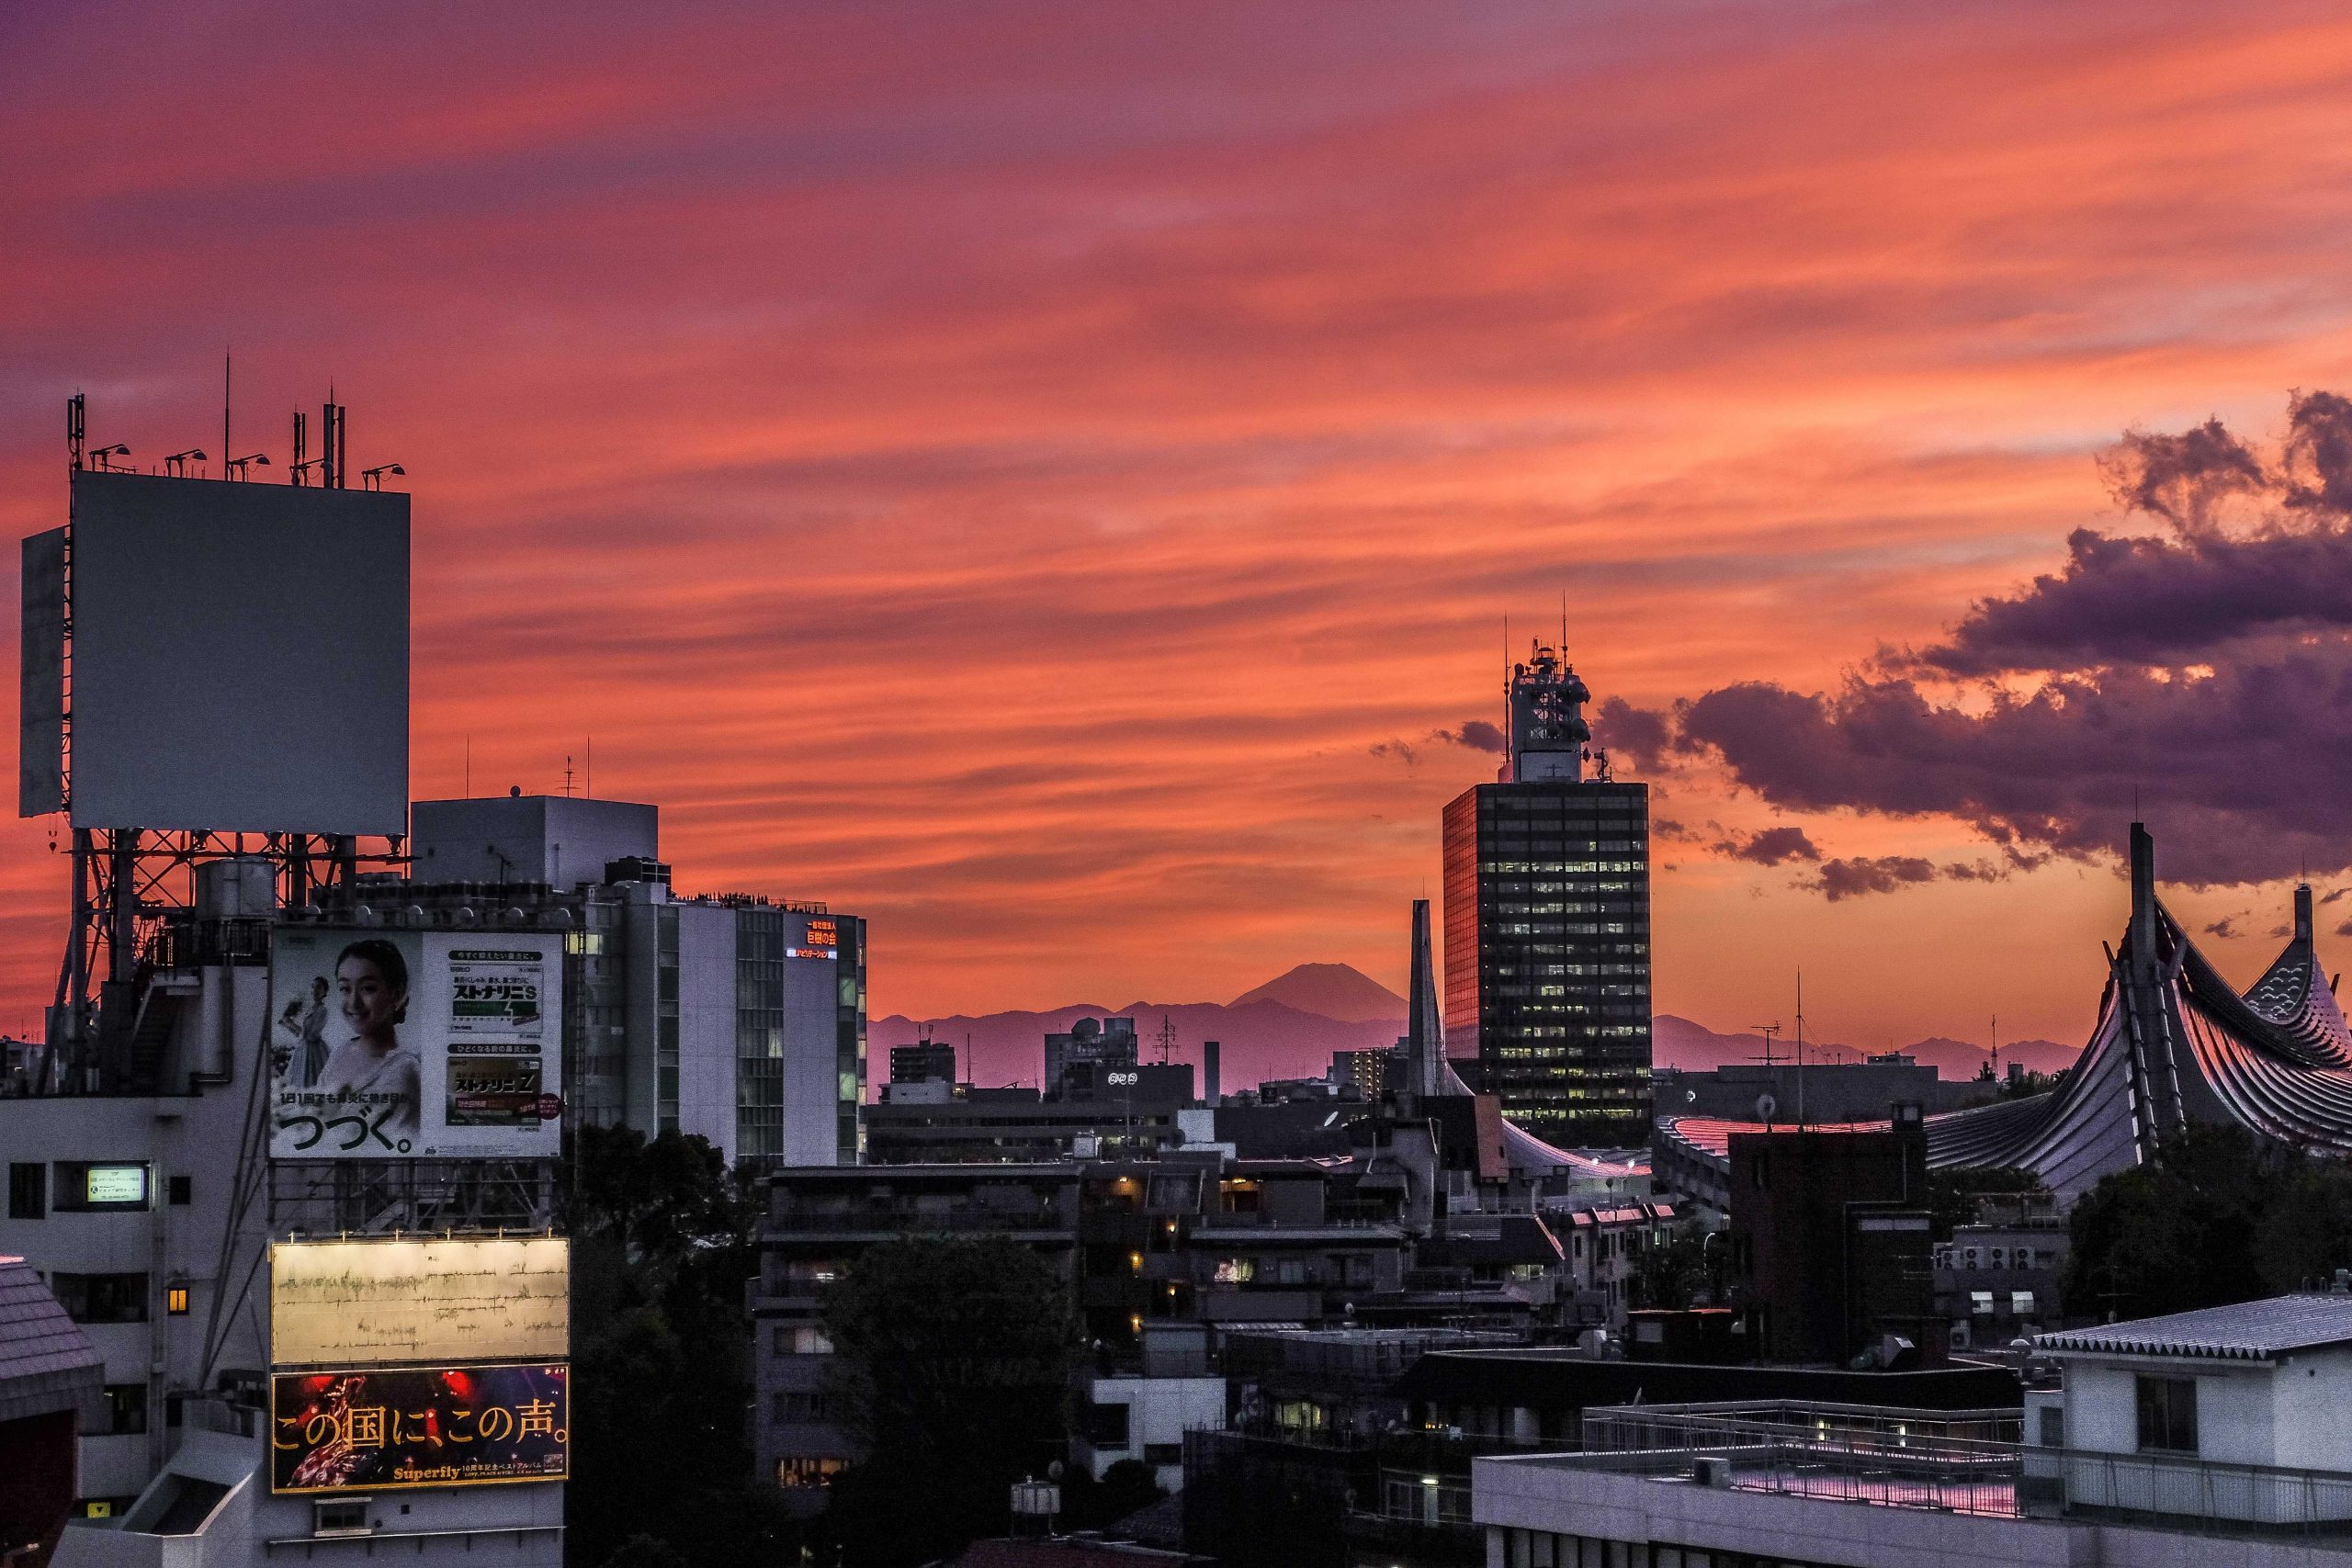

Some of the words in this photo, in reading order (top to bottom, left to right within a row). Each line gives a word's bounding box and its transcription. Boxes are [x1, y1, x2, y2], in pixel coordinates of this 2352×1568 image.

[278, 1106, 412, 1154] つづく。
[273, 1397, 567, 1450] この国に、この声。
[393, 1464, 460, 1482] Superfly
